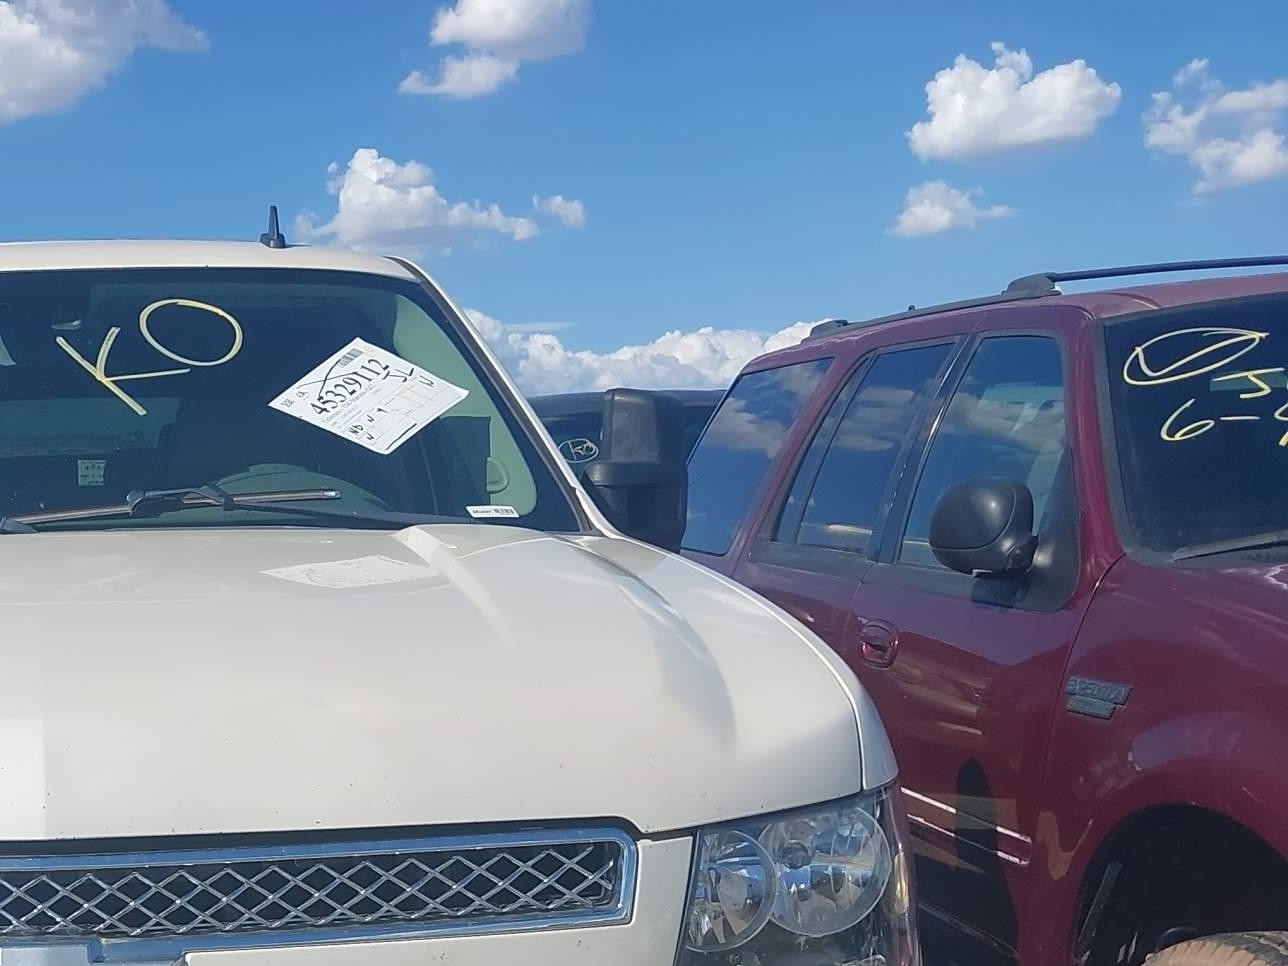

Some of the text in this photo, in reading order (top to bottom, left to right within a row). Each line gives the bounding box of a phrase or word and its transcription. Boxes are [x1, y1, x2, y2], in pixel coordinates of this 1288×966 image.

[56, 298, 243, 416] KO
[310, 357, 390, 415] 45329112
[1160, 398, 1288, 446] 6-
